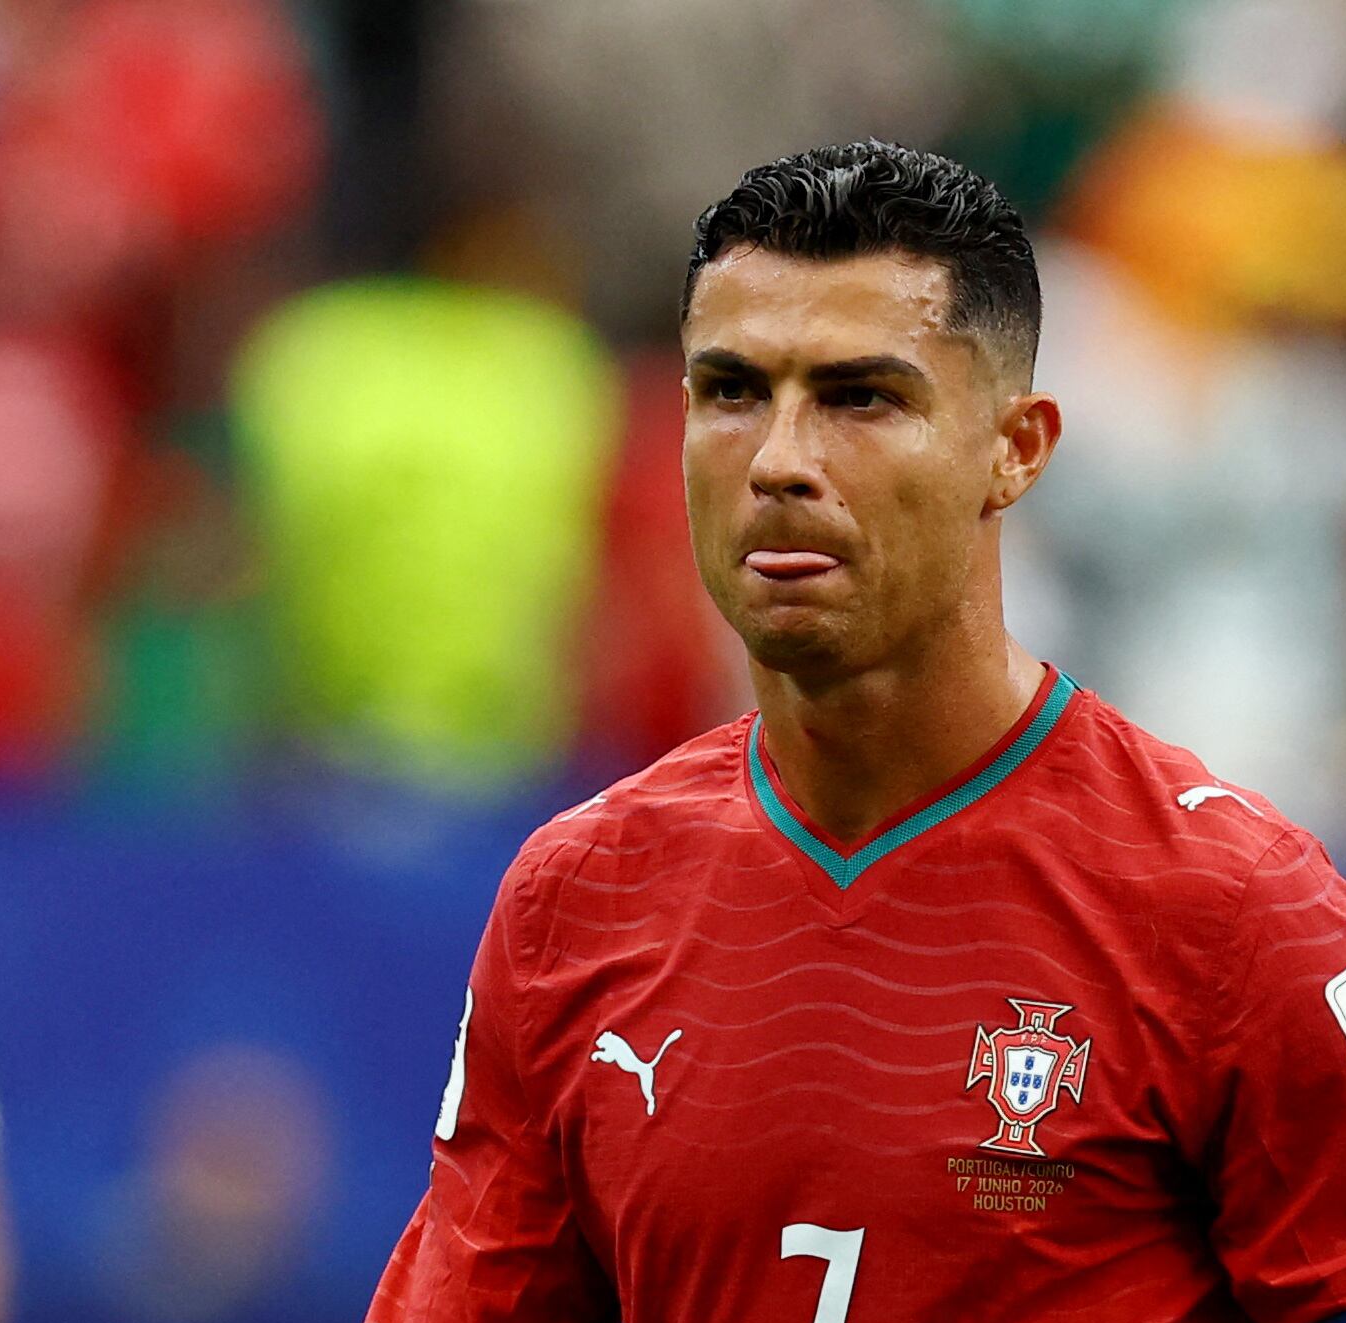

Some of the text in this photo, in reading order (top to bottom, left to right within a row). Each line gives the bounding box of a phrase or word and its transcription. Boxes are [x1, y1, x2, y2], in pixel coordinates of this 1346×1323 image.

[956, 1177, 1064, 1194] 17 JUNHO 2026
[973, 1194, 1046, 1211] HOUSTON
